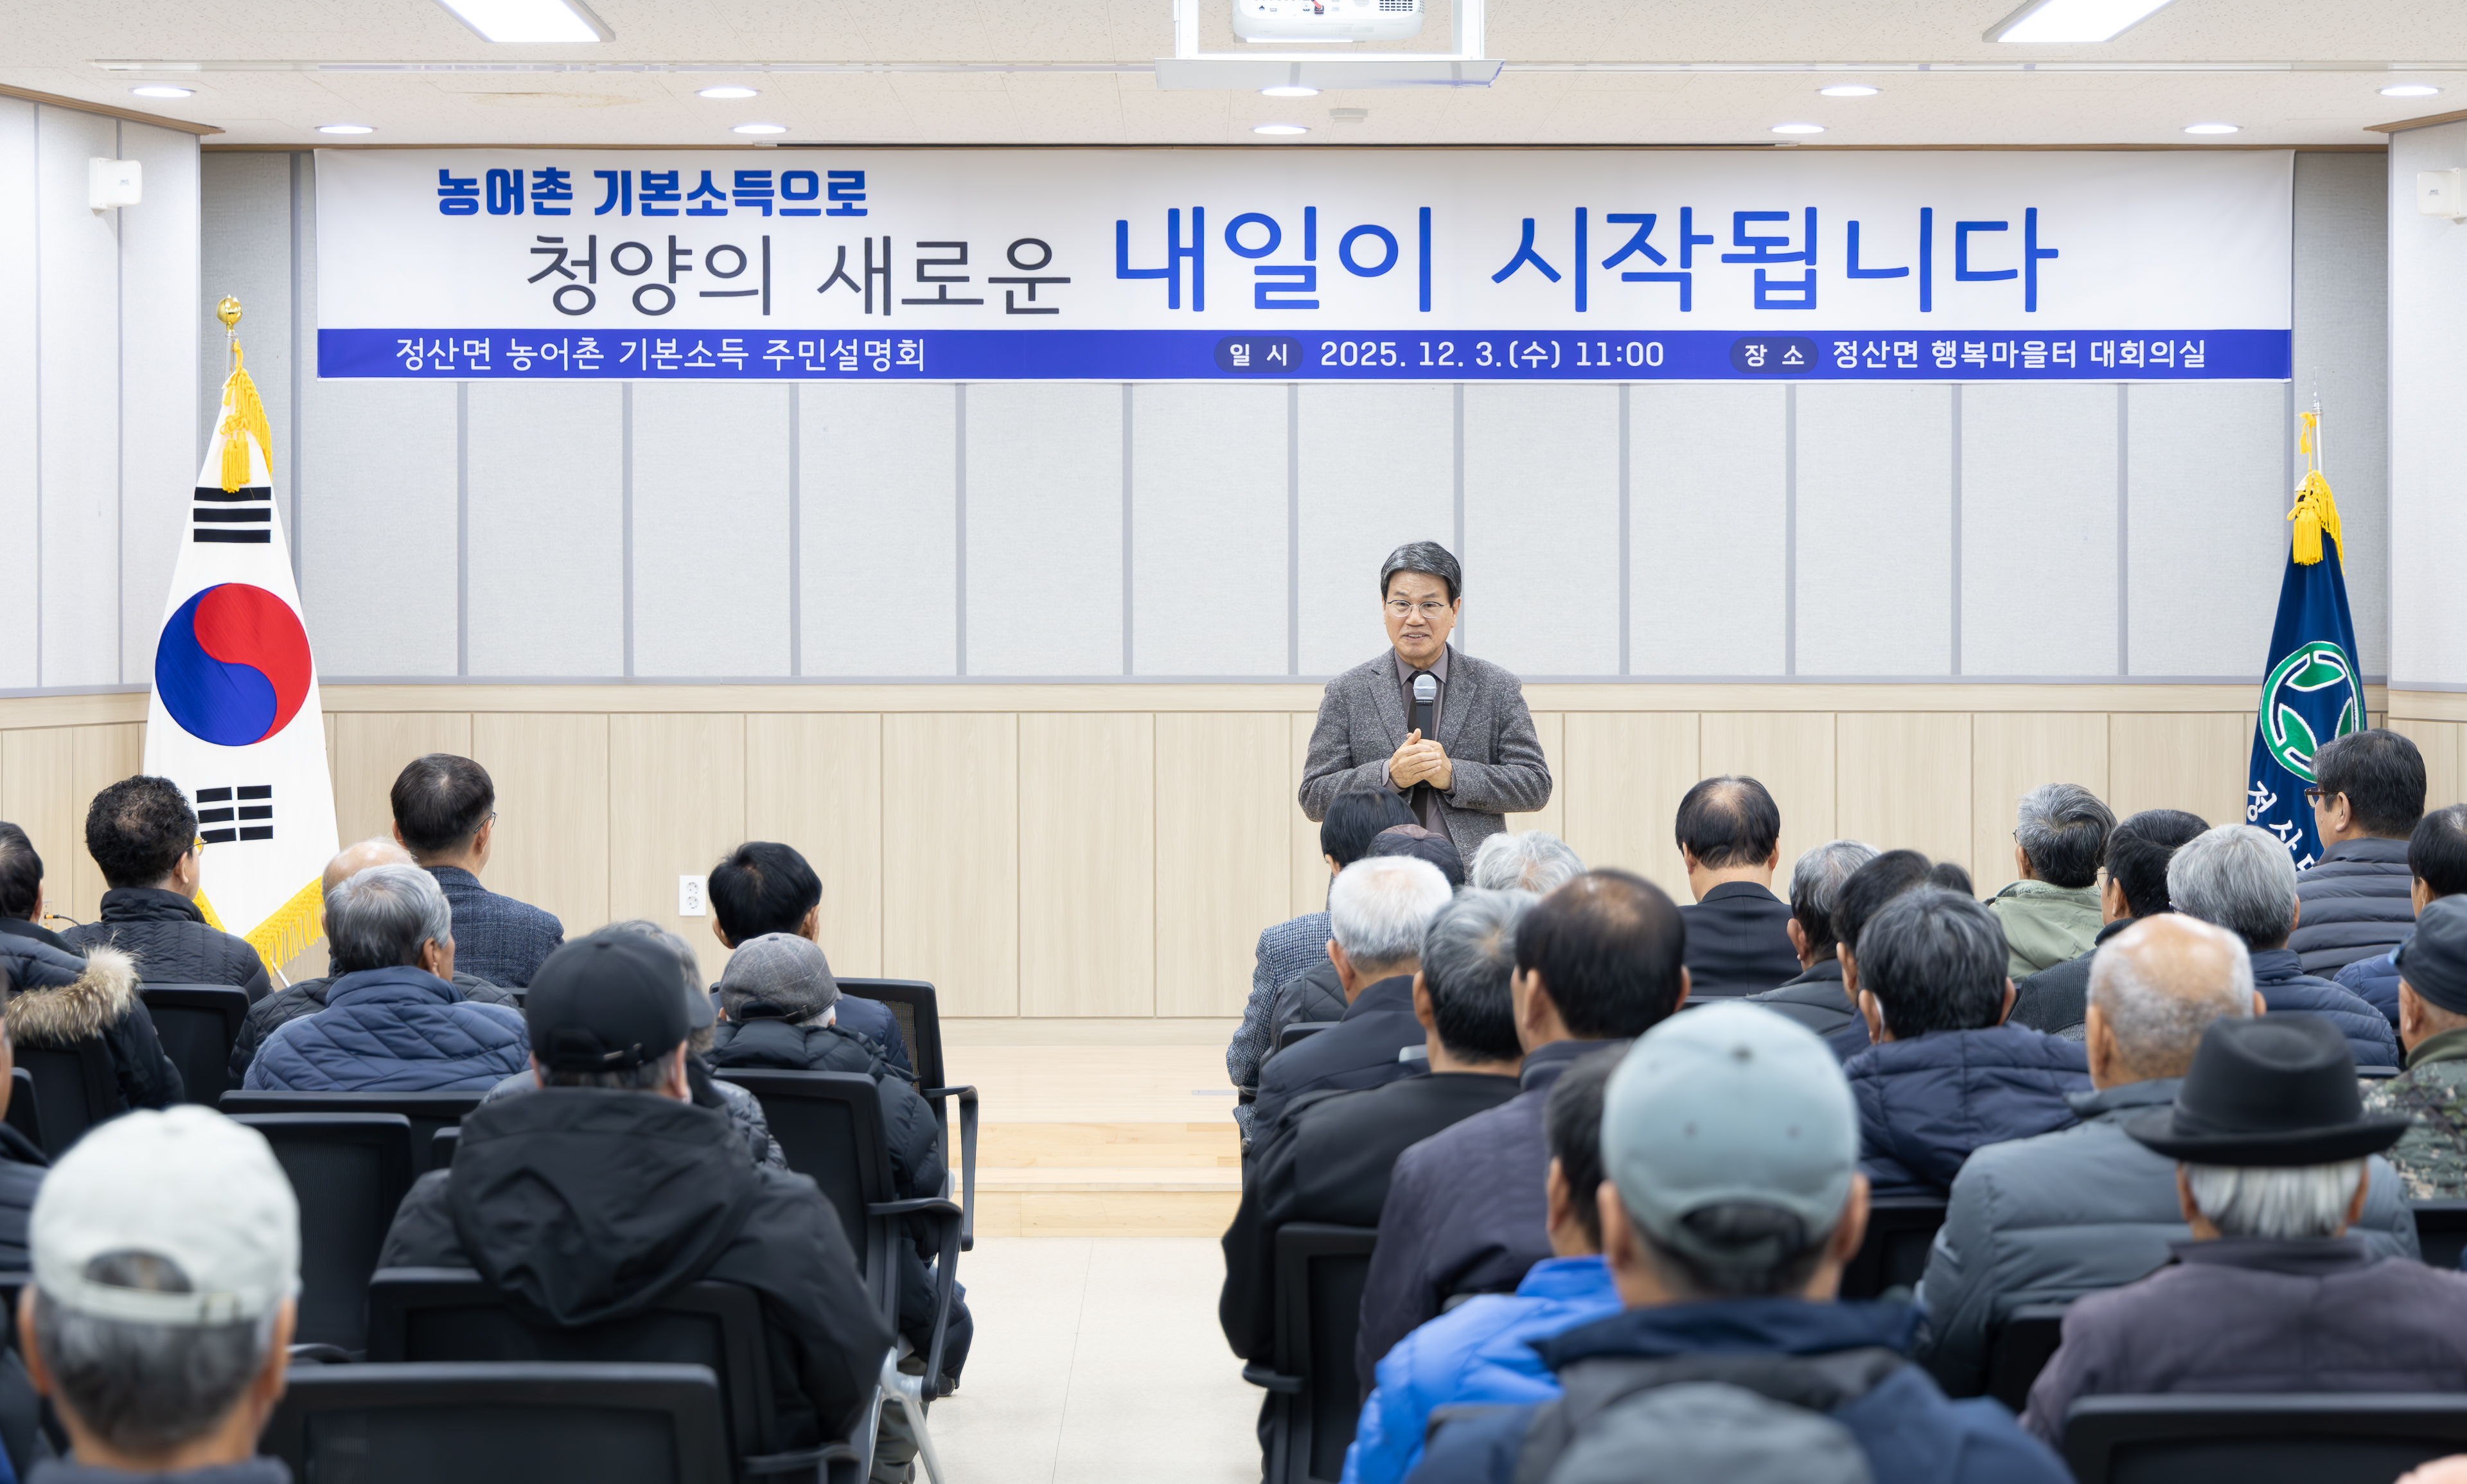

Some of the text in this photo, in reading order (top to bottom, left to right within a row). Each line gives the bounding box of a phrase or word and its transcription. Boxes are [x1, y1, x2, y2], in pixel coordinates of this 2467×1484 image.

[437, 166, 868, 217] 농어촌 기본소득으로
[527, 206, 2059, 316] 청양의 새로운 내일이 시작됩니다
[396, 337, 924, 372] 정산면 농어촌 기본소득 주민설명회
[1321, 340, 1406, 367] 2025.
[1419, 341, 1463, 367] 12.
[1577, 341, 1664, 367] 11:00
[1833, 339, 2205, 369] 정산면 행복마을터 대회의실
